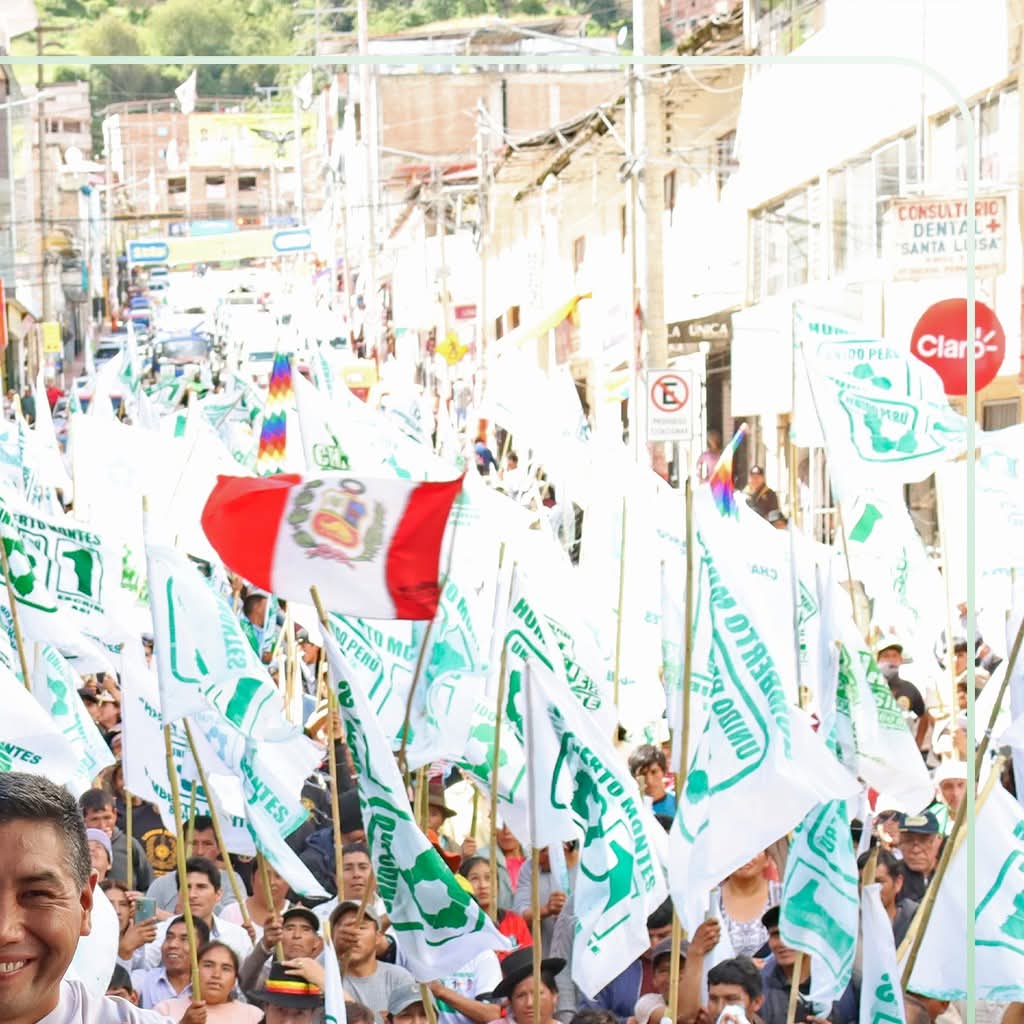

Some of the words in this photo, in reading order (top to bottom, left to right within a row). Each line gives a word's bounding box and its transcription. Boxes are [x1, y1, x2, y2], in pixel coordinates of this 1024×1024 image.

[914, 220, 982, 237] DENTAL
[917, 332, 985, 358] Claro
[346, 635, 380, 672] PERÚ
[620, 799, 658, 893] MONTES
